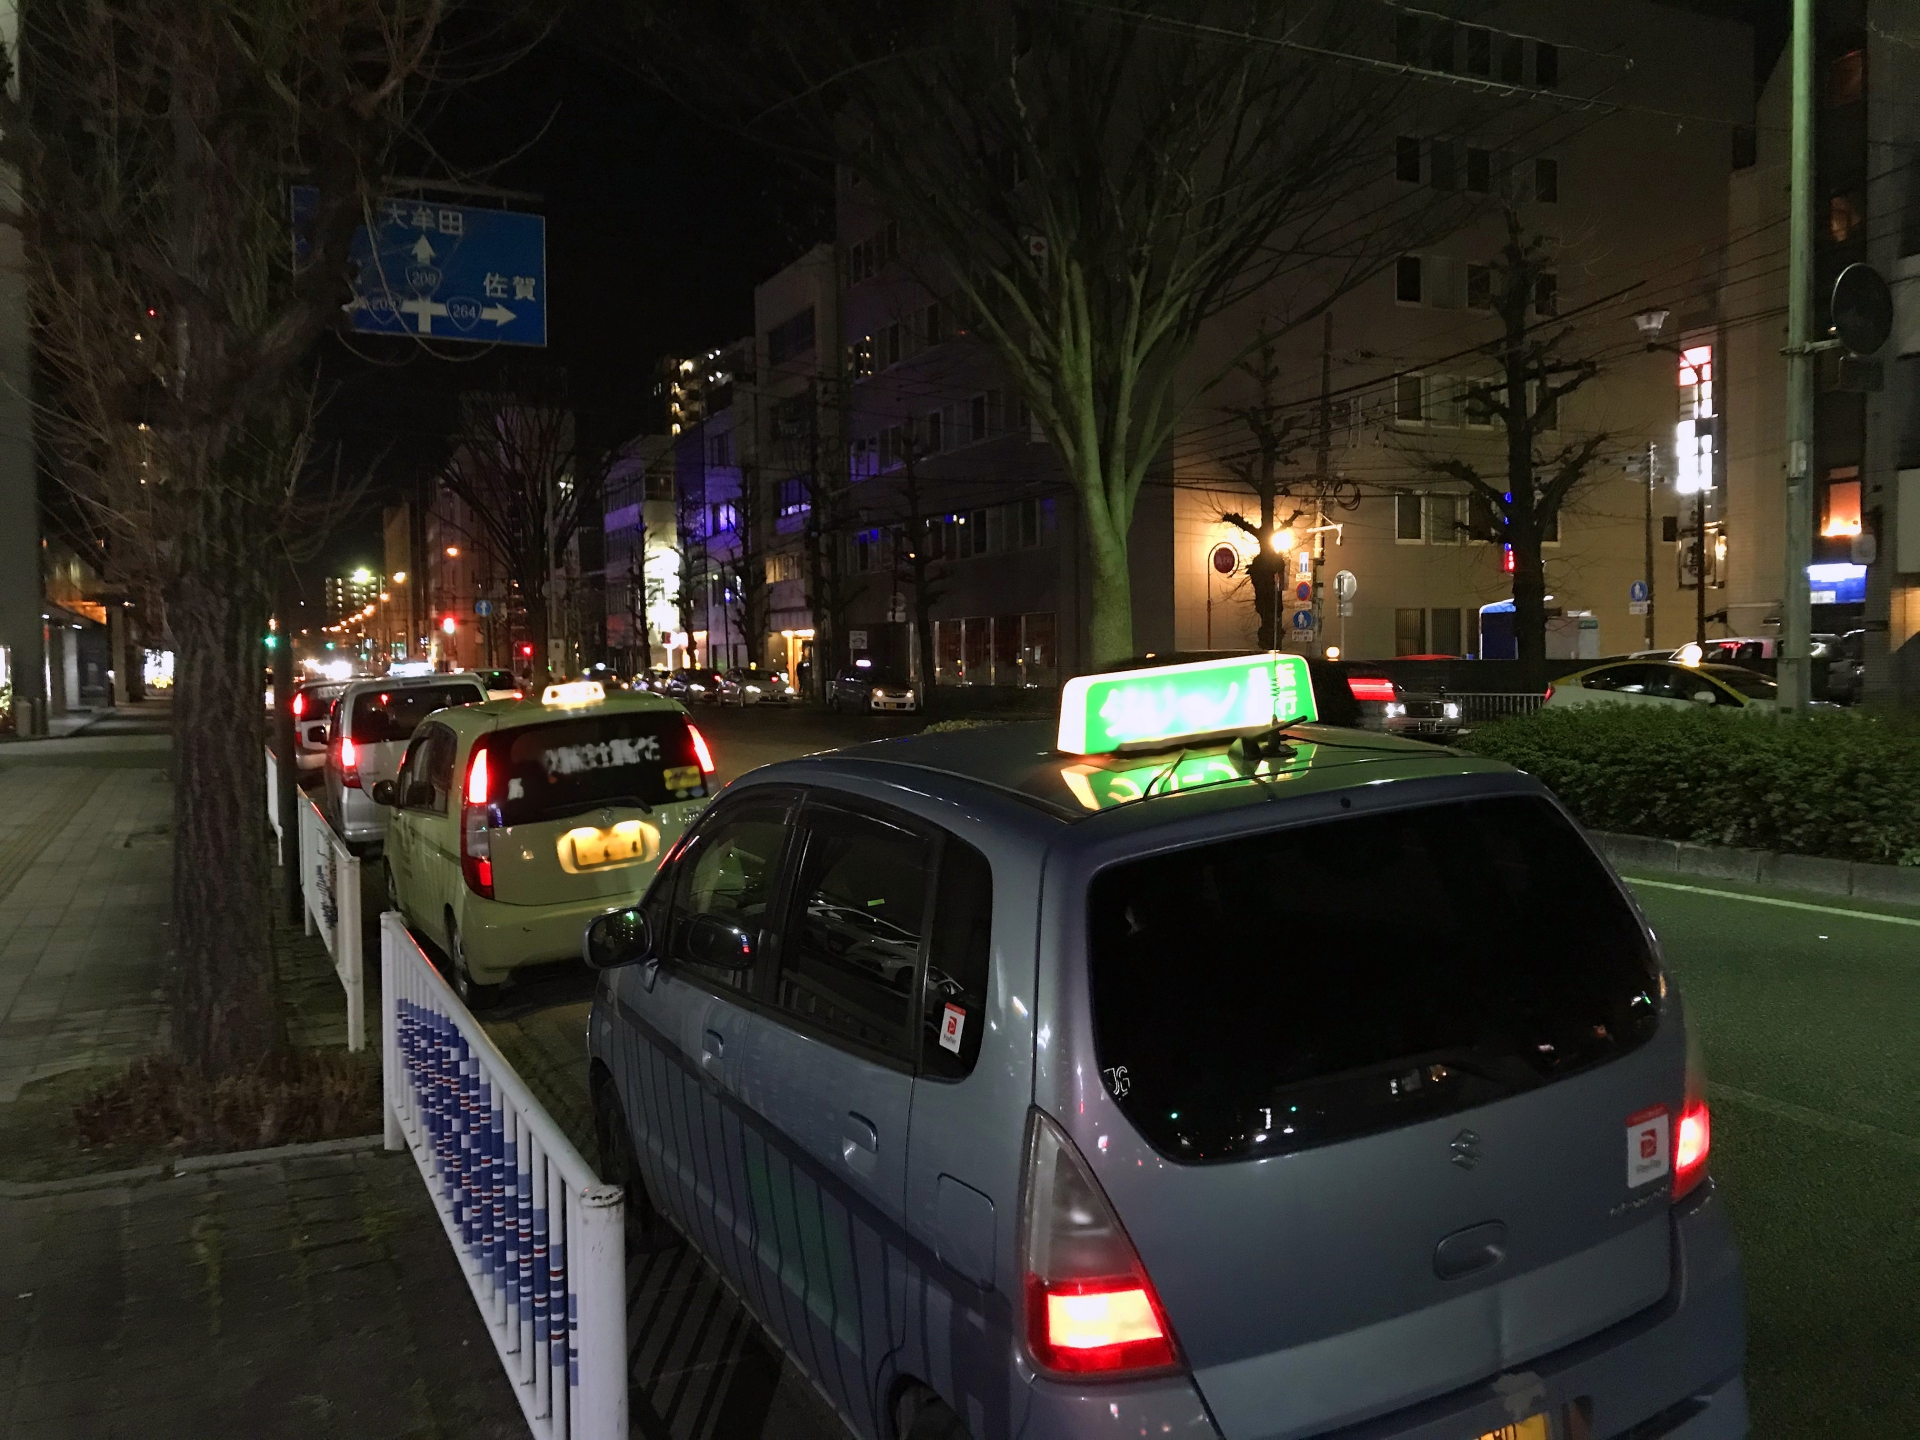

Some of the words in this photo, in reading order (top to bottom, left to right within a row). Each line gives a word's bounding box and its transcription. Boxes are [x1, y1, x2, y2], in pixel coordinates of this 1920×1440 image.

[385, 203, 463, 234] 大牟田
[483, 271, 536, 302] 佐賀
[452, 304, 476, 318] 264
